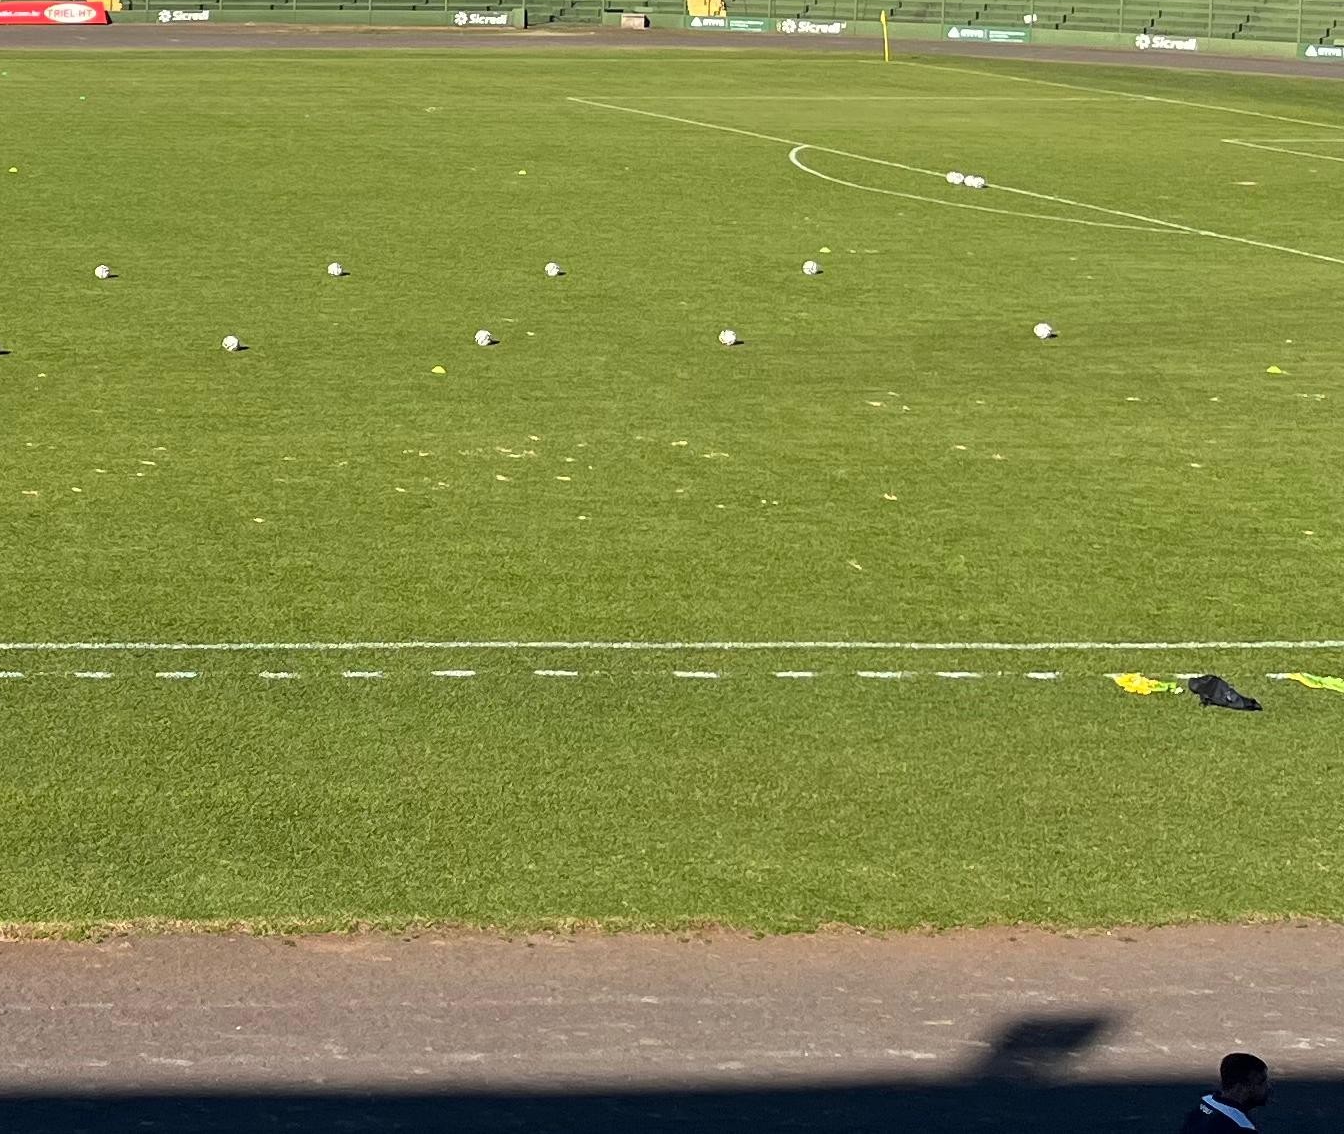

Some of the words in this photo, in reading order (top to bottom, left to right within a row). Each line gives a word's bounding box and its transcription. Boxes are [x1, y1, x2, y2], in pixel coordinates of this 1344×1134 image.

[172, 10, 210, 21] Sicredi
[469, 13, 508, 25] Sicredi
[797, 20, 841, 34] Sicredi
[1151, 35, 1197, 51] Sicredi
